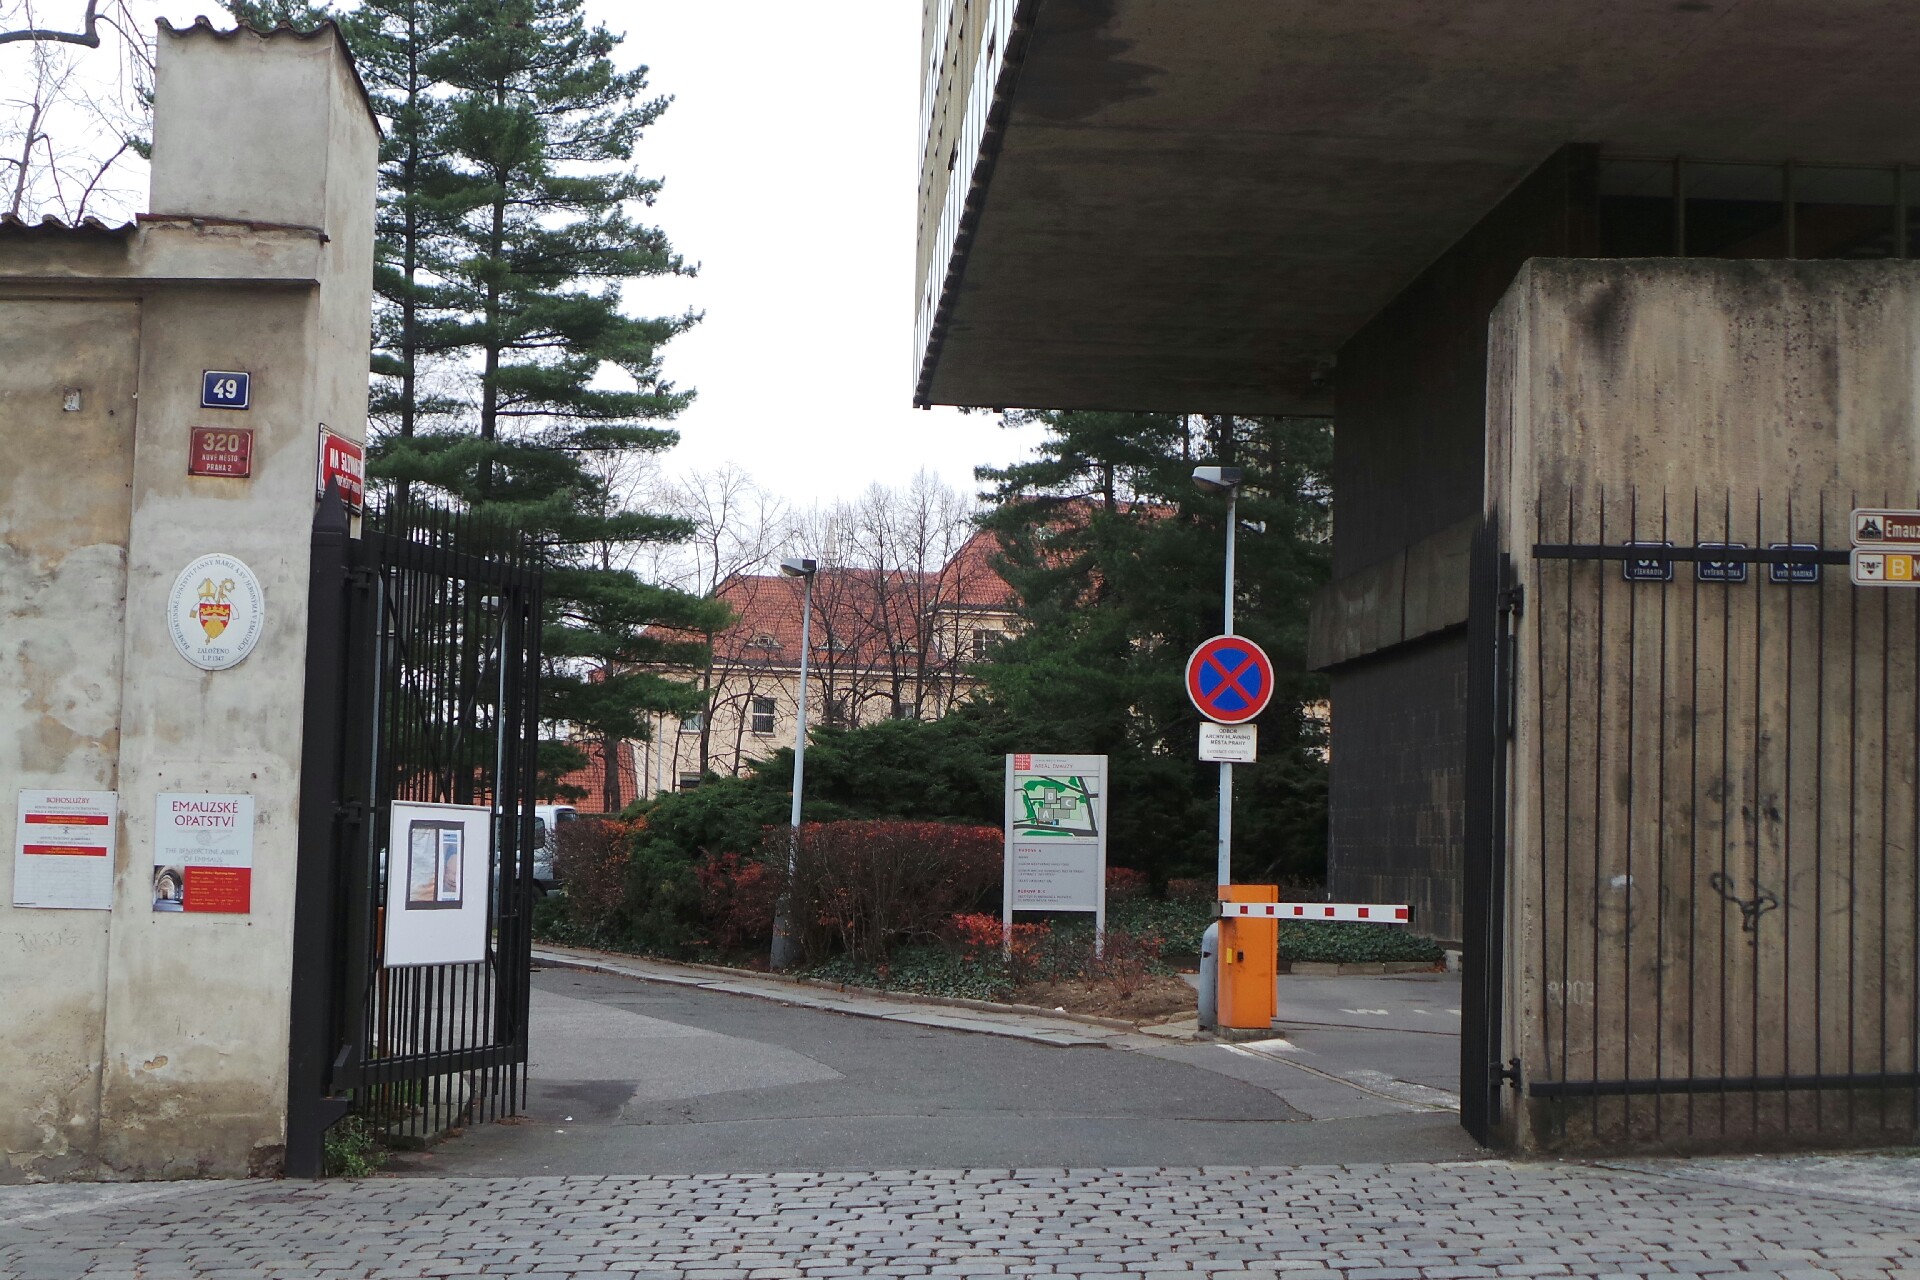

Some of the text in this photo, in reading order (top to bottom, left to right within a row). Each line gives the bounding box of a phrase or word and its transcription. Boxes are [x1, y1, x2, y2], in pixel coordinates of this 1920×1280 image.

[213, 379, 237, 398] 49
[203, 433, 239, 452] 320
[202, 453, 238, 462] NOVÉ MĚSTO
[1892, 559, 1905, 576] B
[1047, 792, 1054, 800] B
[172, 799, 239, 814] EMAUZSKÉ
[174, 814, 234, 827] OPATSTVÍ
[1042, 810, 1050, 818] A
